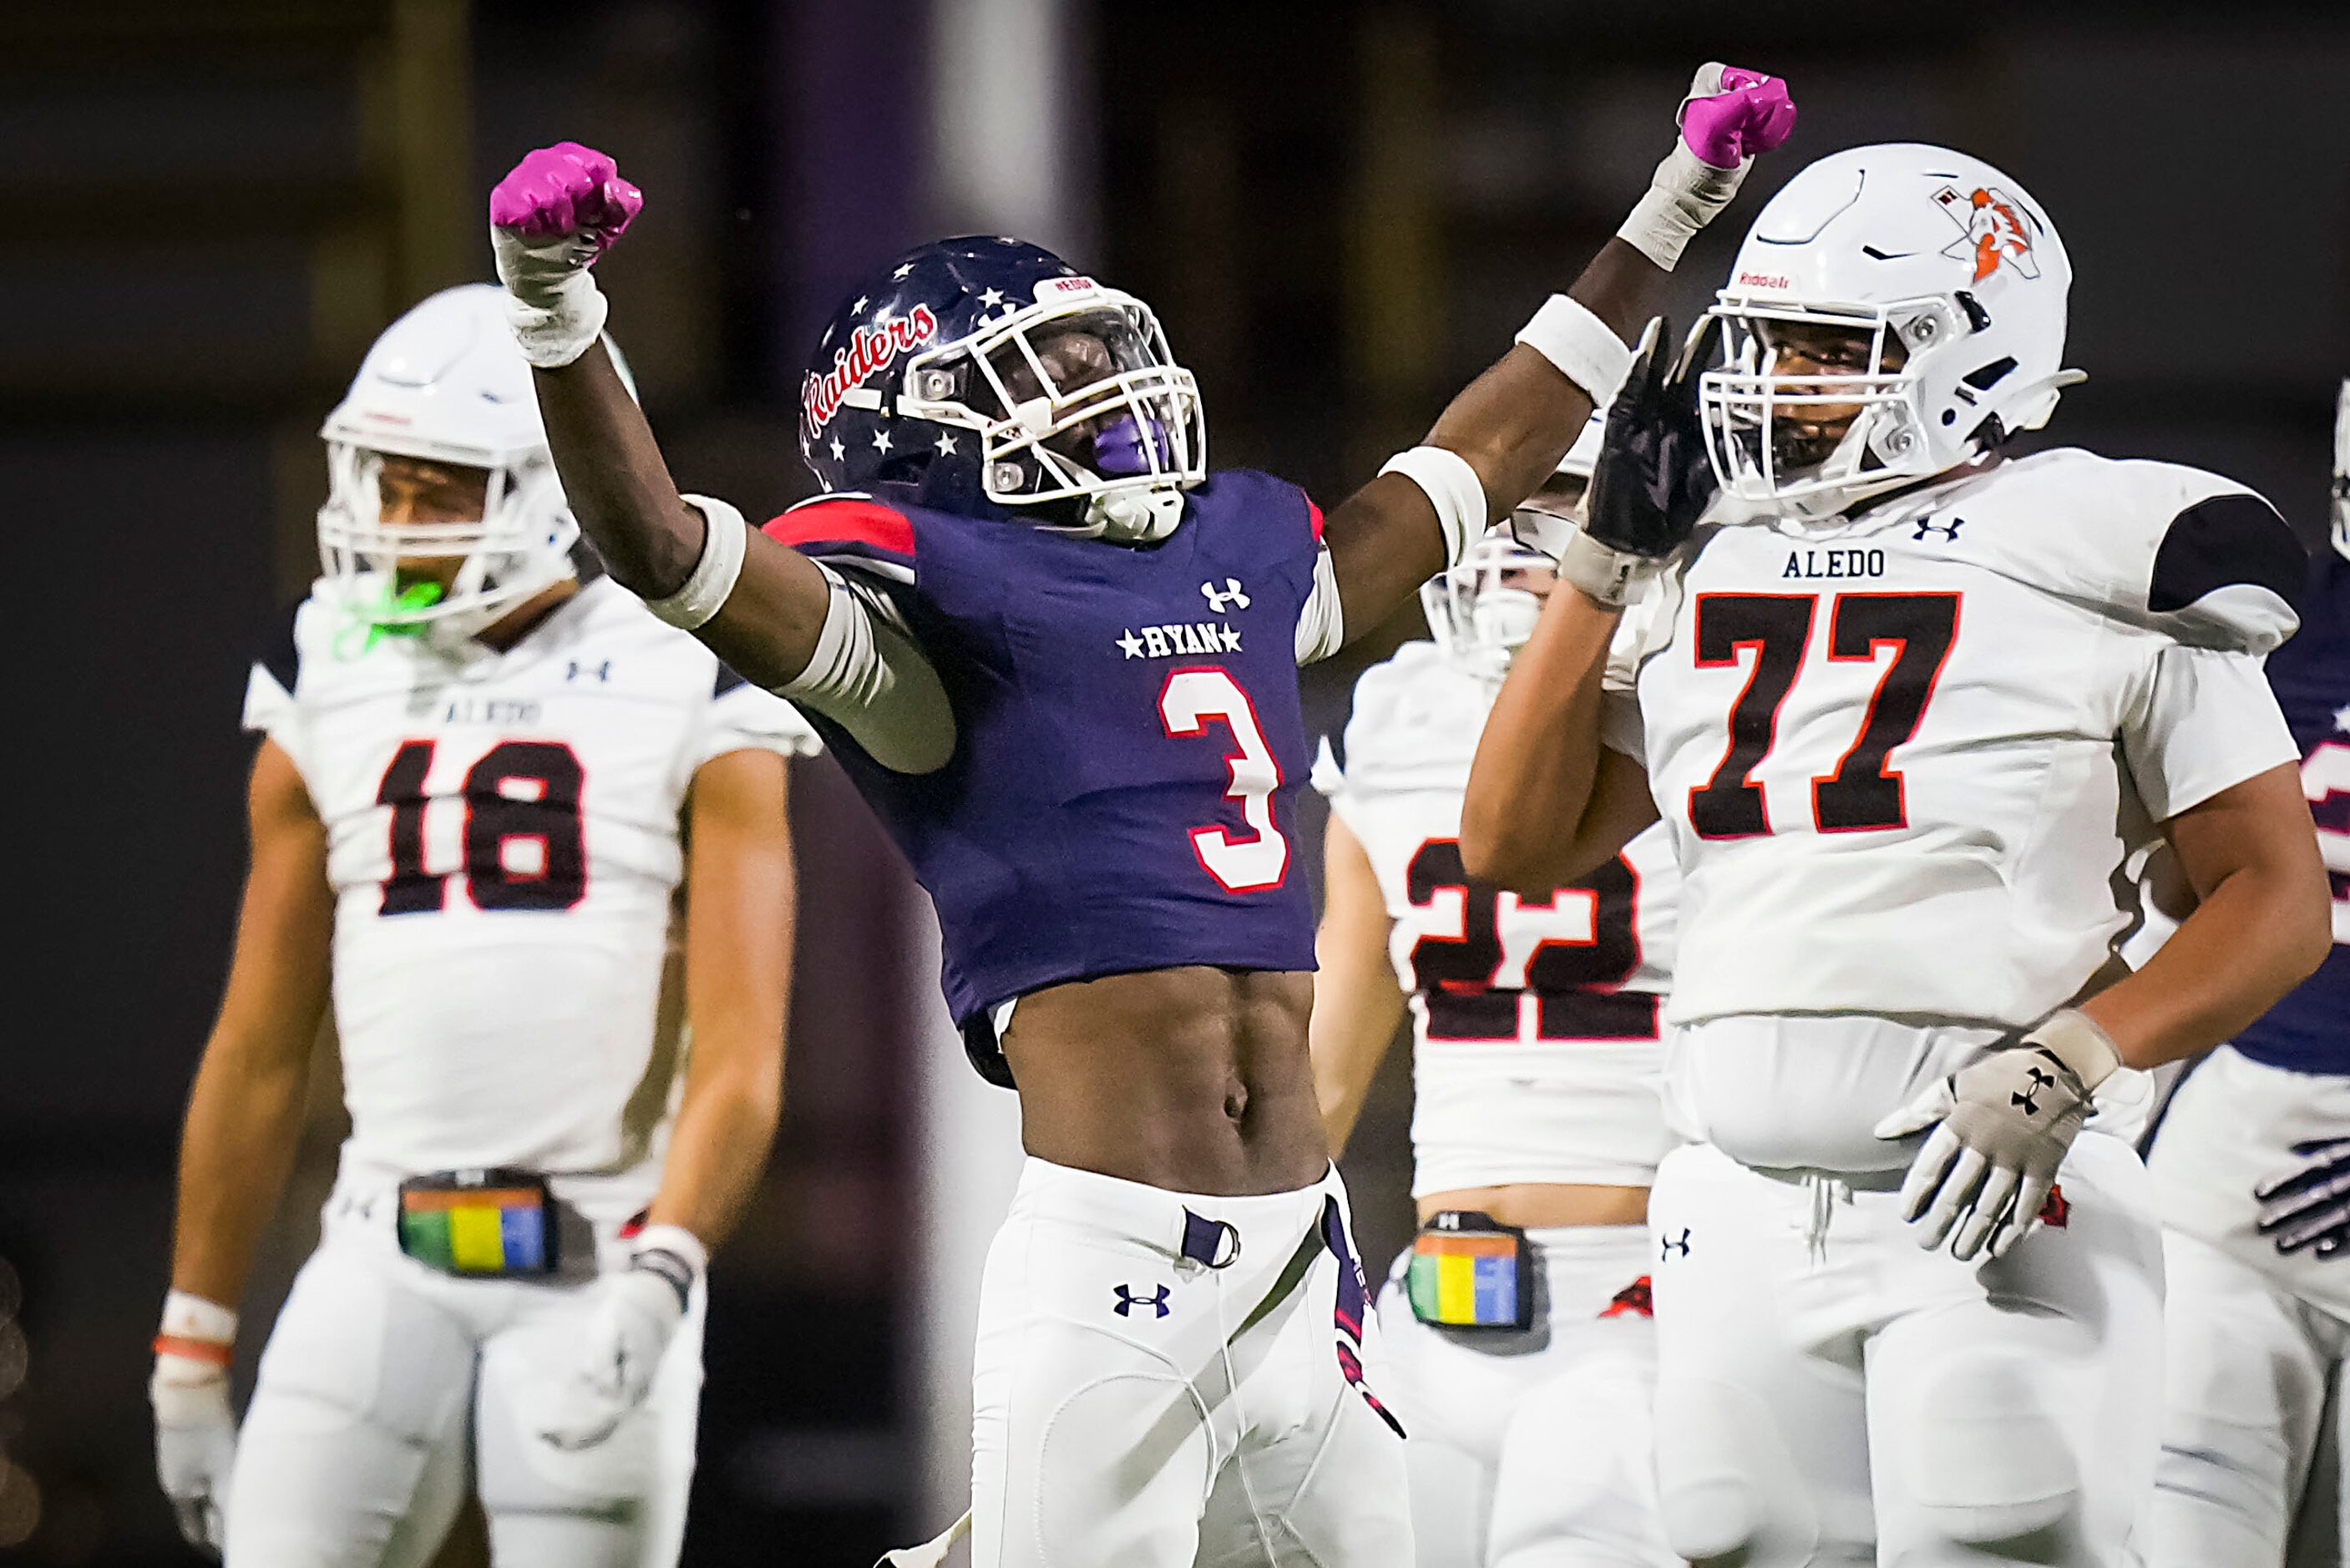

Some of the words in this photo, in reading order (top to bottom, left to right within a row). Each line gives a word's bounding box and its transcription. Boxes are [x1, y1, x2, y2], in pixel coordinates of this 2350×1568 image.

[805, 303, 937, 439] Raiders
[1142, 624, 1222, 658] RYAN
[1782, 549, 1884, 578] ALEDO
[1157, 665, 1291, 894] 3
[1688, 591, 1963, 841] 77
[376, 740, 588, 916] 18
[1406, 837, 1660, 1041] 22
